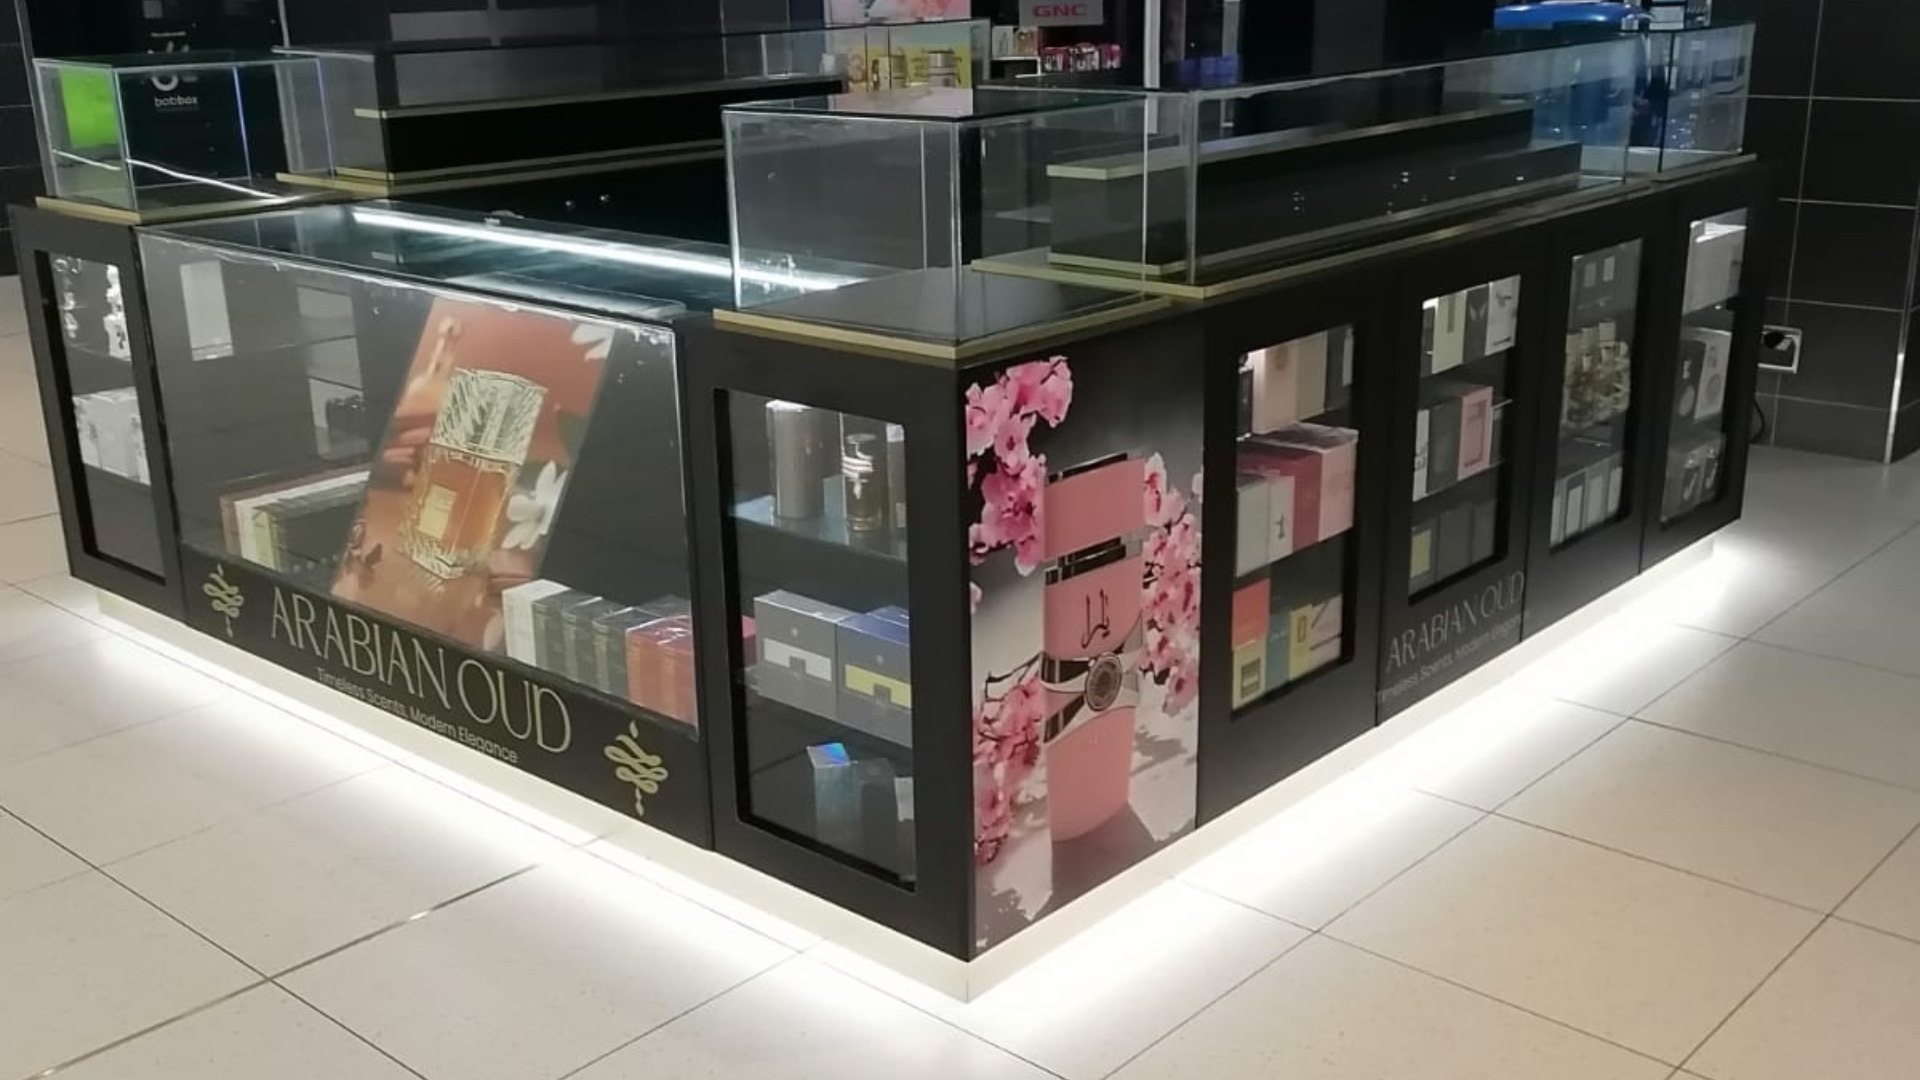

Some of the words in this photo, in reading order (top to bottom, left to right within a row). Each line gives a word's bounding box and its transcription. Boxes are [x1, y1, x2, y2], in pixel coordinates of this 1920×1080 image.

[1033, 5, 1088, 17] GNC
[271, 586, 451, 709] ARABIAN
[457, 658, 572, 753] OUD
[1386, 595, 1477, 674] ARABIAN
[1480, 571, 1524, 618] OUD
[317, 666, 365, 699] Timeless
[410, 706, 457, 737] Modern
[458, 726, 518, 763] Elegance
